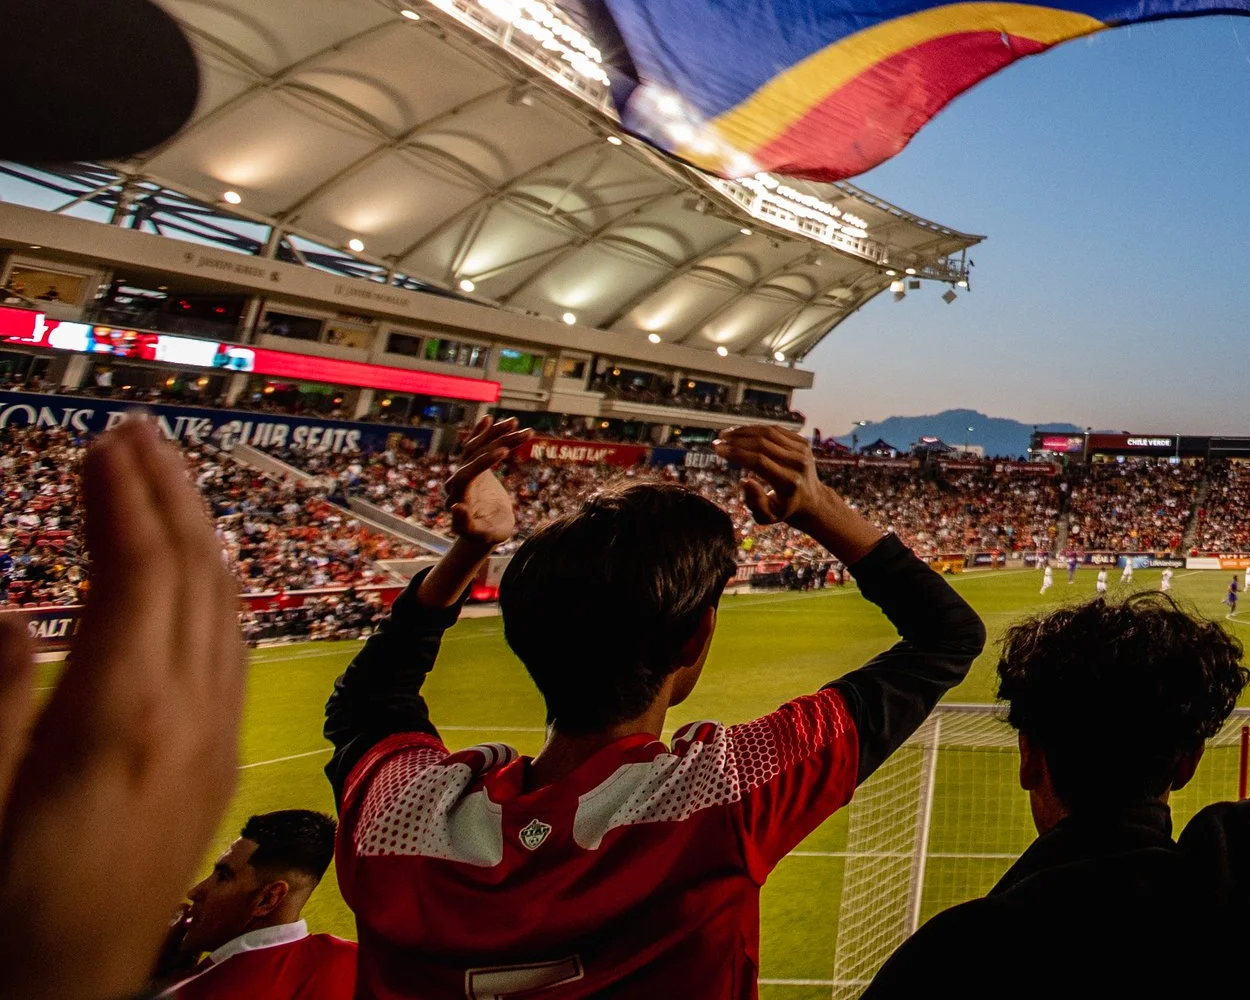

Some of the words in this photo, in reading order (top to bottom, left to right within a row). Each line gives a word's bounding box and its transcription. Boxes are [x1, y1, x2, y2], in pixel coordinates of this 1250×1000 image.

[0, 403, 95, 433] ONS
[104, 411, 210, 444] BNK
[290, 424, 361, 453] SEATS
[1127, 438, 1148, 446] CHILE
[1148, 438, 1171, 447] VERDE
[559, 446, 587, 461] SALT
[28, 618, 73, 638] SALT
